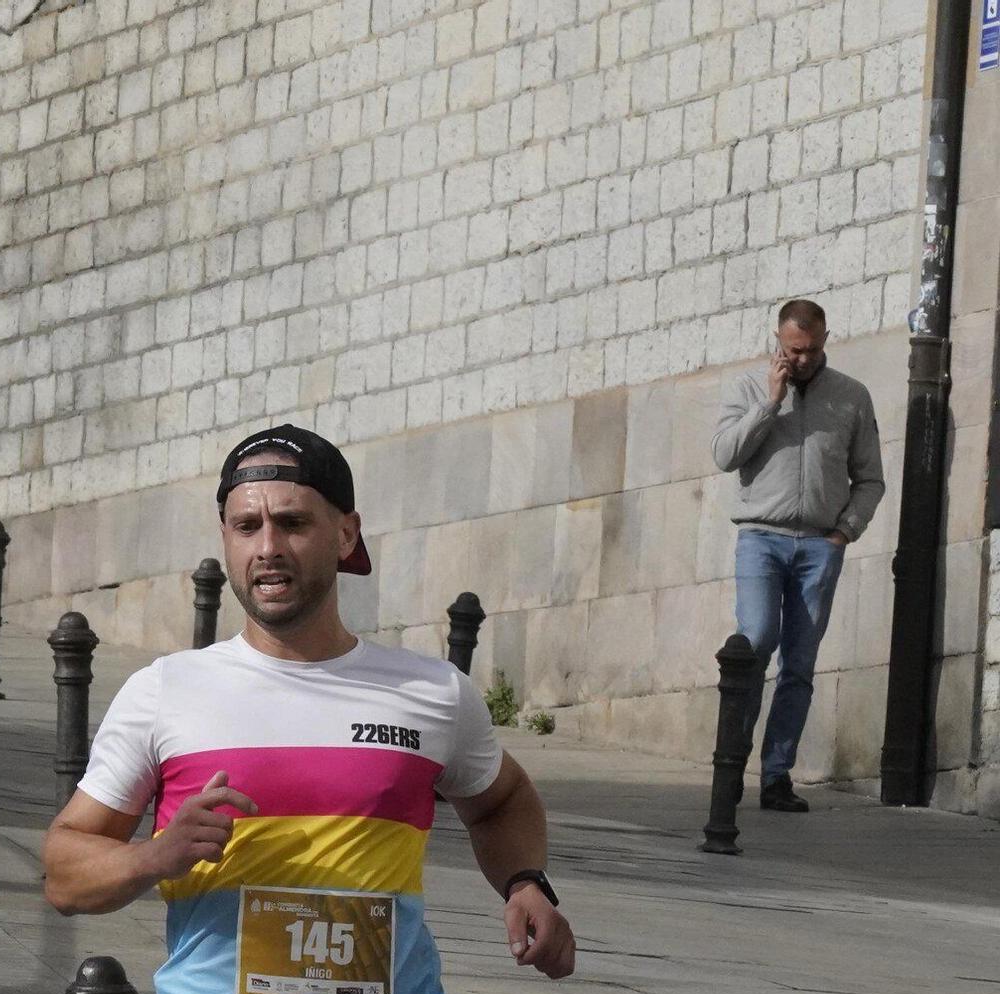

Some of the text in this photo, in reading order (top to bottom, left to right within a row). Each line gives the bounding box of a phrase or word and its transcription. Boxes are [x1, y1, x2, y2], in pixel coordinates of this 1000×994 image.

[351, 723, 421, 751] 226ERS
[285, 920, 355, 966] 145
[305, 966, 333, 979] IÑIGO
